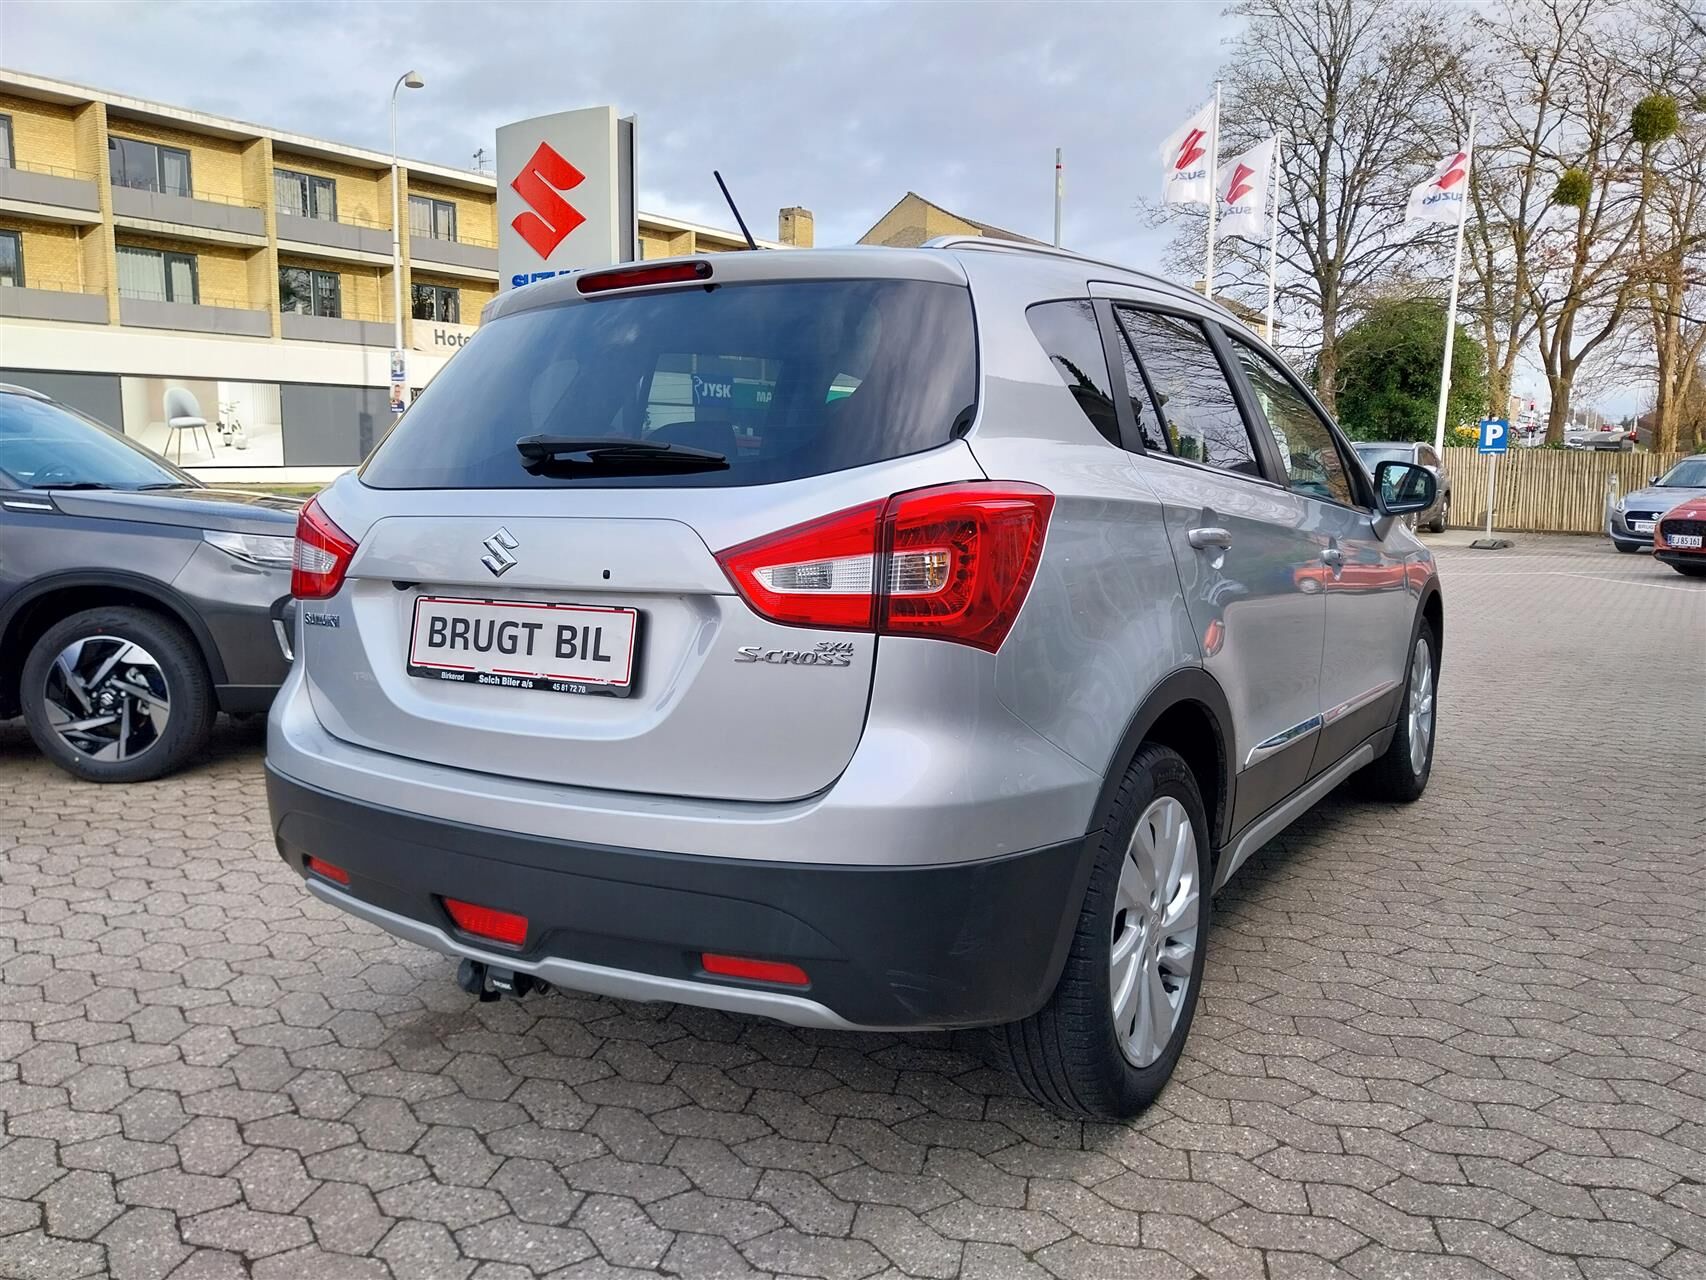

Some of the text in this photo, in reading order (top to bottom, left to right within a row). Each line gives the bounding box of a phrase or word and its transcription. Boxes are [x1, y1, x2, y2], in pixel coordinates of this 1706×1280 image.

[702, 382, 731, 398] JYSK
[1485, 424, 1504, 446] P
[1681, 537, 1689, 545] 85
[1690, 537, 1701, 546] 161
[428, 616, 612, 664] BRUGT BIL
[813, 641, 854, 654] SX4
[734, 646, 854, 667] S-CROSS
[478, 674, 534, 689] Selch Biler a/s
[552, 683, 586, 693] 45 81 72 78
